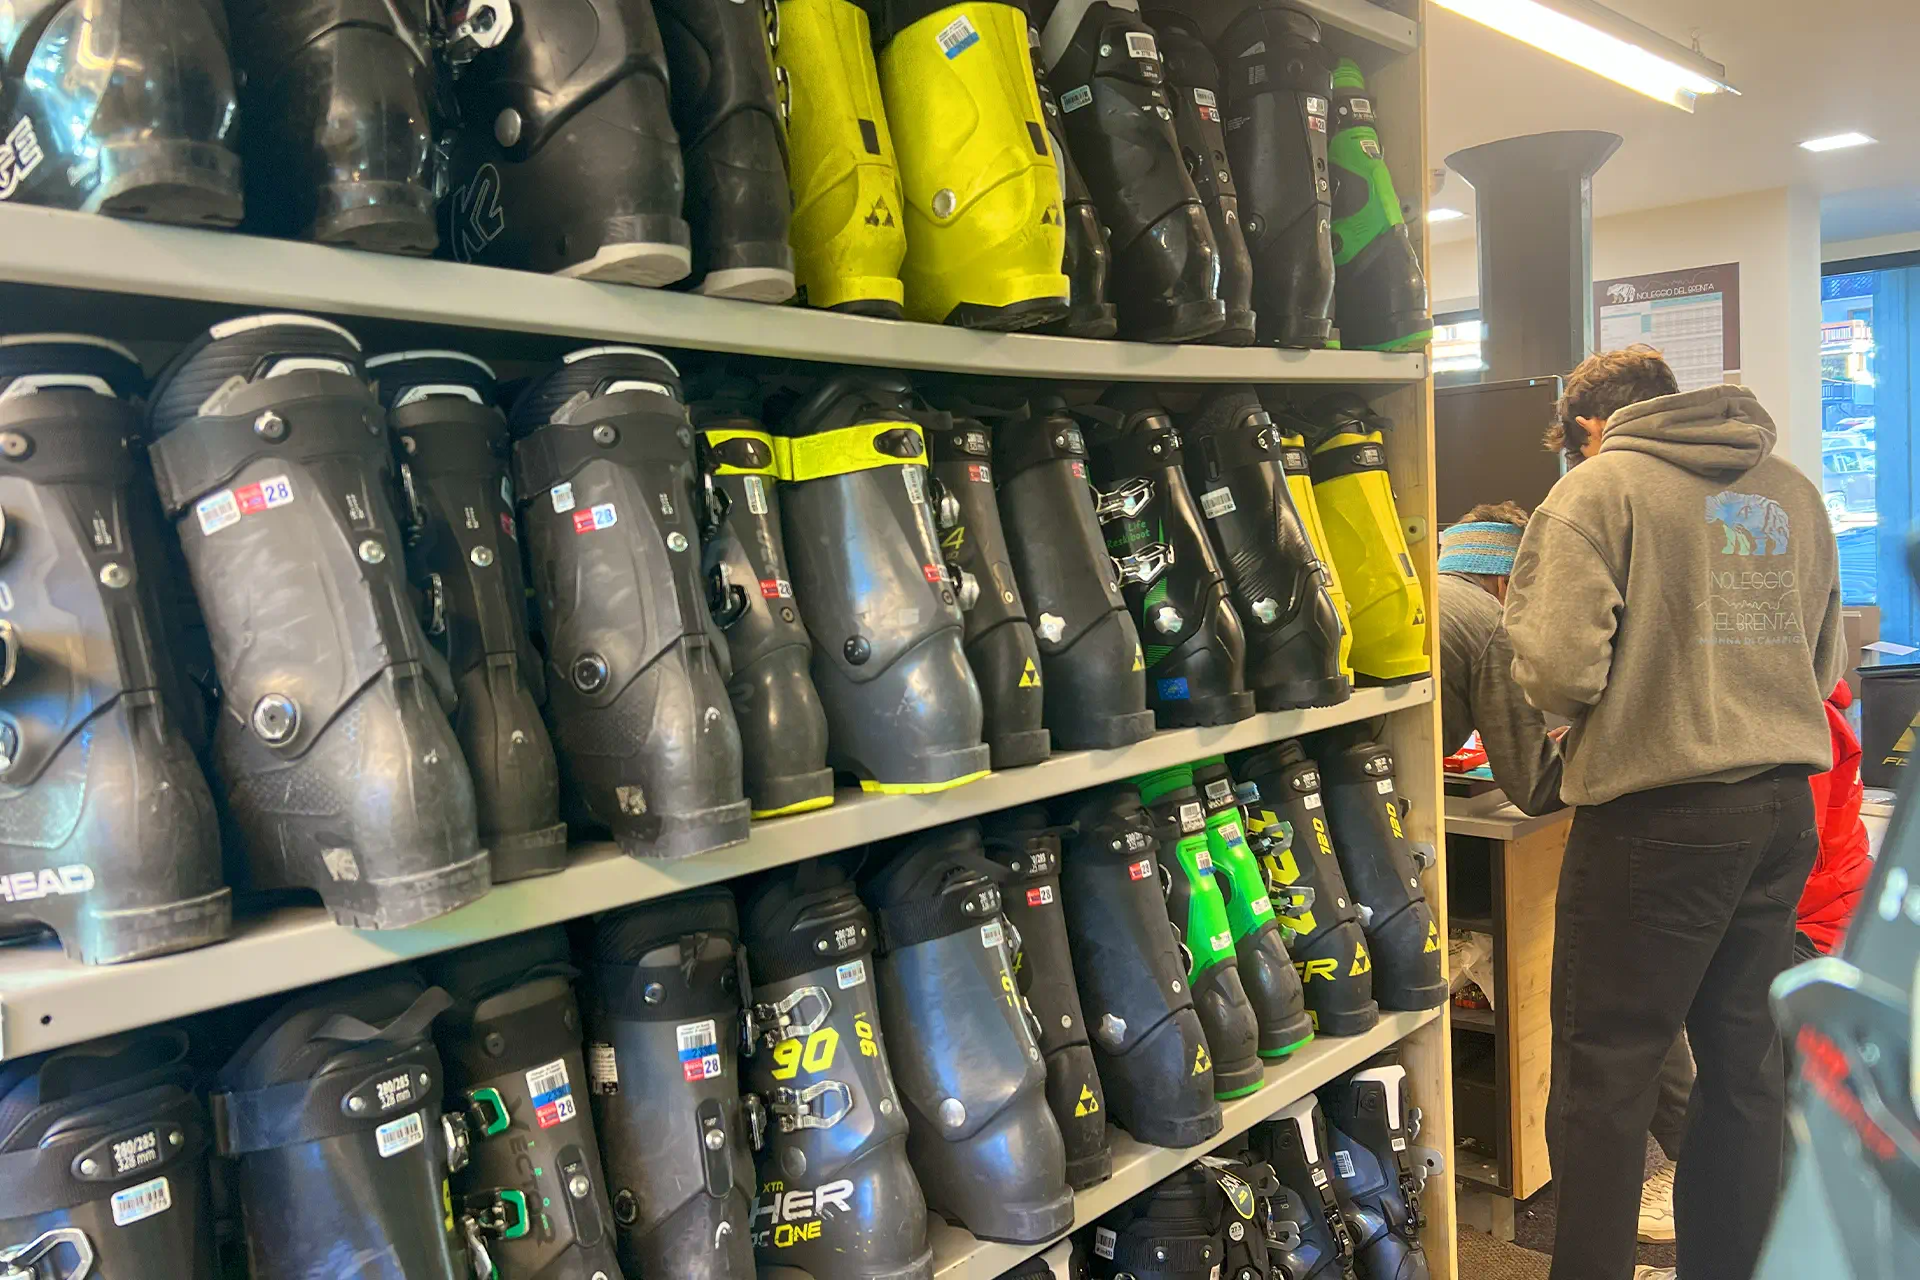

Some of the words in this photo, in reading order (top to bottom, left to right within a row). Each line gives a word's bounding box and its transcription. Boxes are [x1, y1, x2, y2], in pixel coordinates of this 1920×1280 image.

[451, 163, 505, 263] K2
[1636, 289, 1673, 300] NOLEGGIO
[1674, 287, 1687, 296] DEL
[1688, 283, 1715, 294] BRENTA
[264, 482, 289, 502] 28
[595, 508, 615, 524] 28
[940, 525, 966, 550] 4
[778, 582, 792, 597] 28
[1710, 570, 1795, 590] NOLEGGIO
[1714, 612, 1735, 631] EL
[1736, 612, 1802, 632] BRENTA
[1384, 802, 1404, 840] 120
[1312, 817, 1332, 855] 120
[1142, 861, 1150, 873] 28
[1040, 888, 1052, 901] 28
[854, 1020, 878, 1057] 90
[772, 1027, 840, 1080] 90
[704, 1058, 719, 1074] 28
[558, 1099, 574, 1118] 28
[113, 1131, 156, 1160] 280/285
[117, 1156, 137, 1173] 328
[136, 1149, 157, 1166] mm
